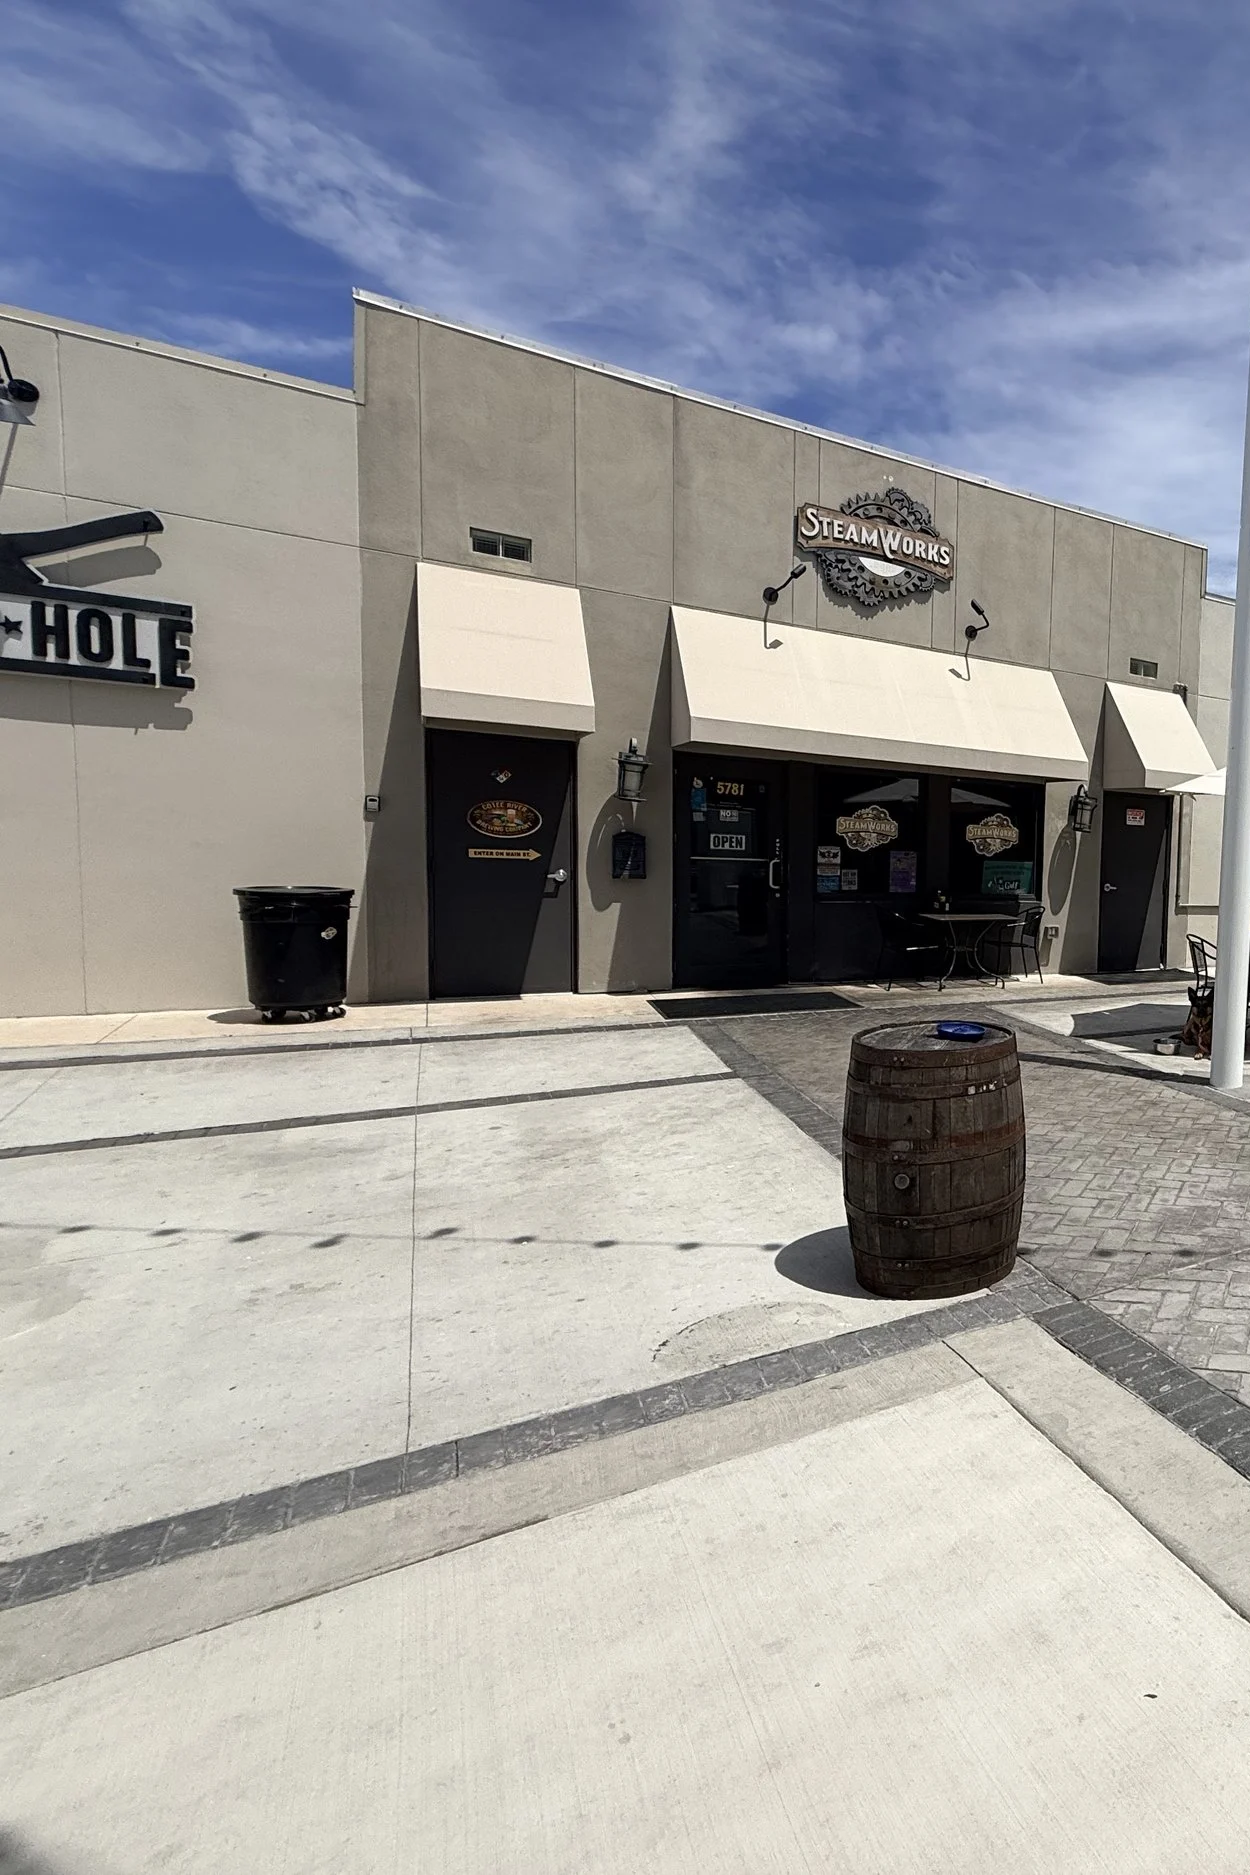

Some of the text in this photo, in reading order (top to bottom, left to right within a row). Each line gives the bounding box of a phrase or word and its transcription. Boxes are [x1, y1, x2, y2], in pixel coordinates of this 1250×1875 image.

[31, 601, 195, 689] HOLE
[716, 782, 744, 795] 5781
[507, 803, 528, 812] RIVER
[713, 835, 743, 849] OPEN
